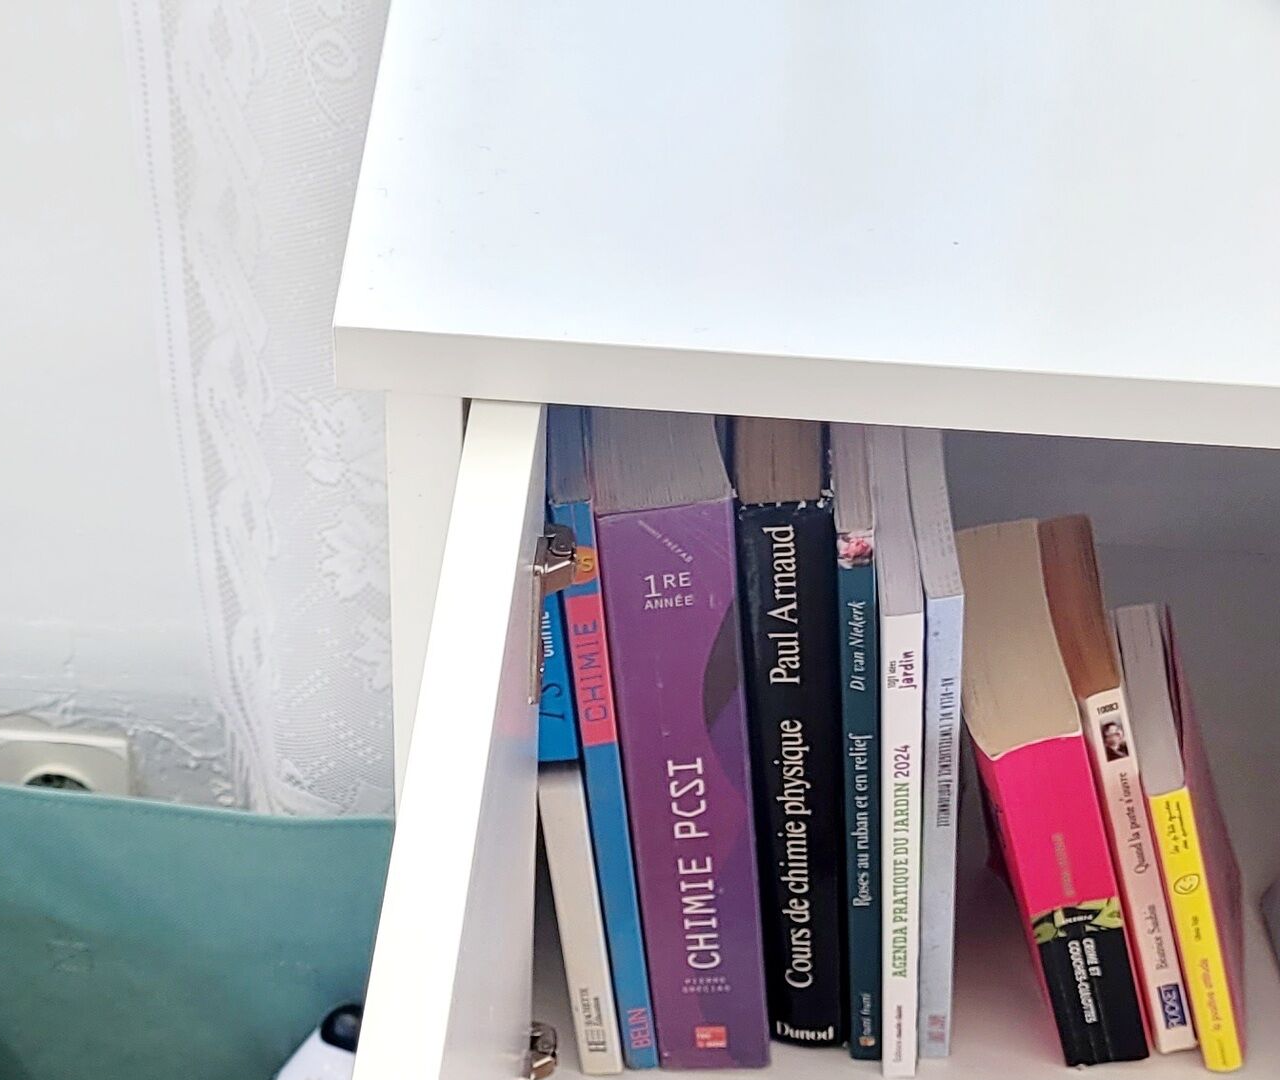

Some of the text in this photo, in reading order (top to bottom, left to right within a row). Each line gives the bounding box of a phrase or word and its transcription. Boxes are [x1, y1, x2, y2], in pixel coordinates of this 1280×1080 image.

[644, 571, 692, 598] 1RE
[644, 593, 694, 611] ANNÉE
[761, 523, 801, 685] Paul Arnaud
[573, 619, 608, 722] CHIMIE
[852, 651, 866, 674] van
[898, 649, 918, 690] jardin
[773, 719, 813, 989] Cours de chimie physique
[848, 733, 873, 907] Roses au ruban et en relief
[667, 757, 721, 970] CHIMIE PCSI
[891, 744, 912, 978] AGENDA PRATIQUE DU JARDIN 2024
[627, 1008, 652, 1049] BELIN
[776, 1020, 835, 1042] Dunod
